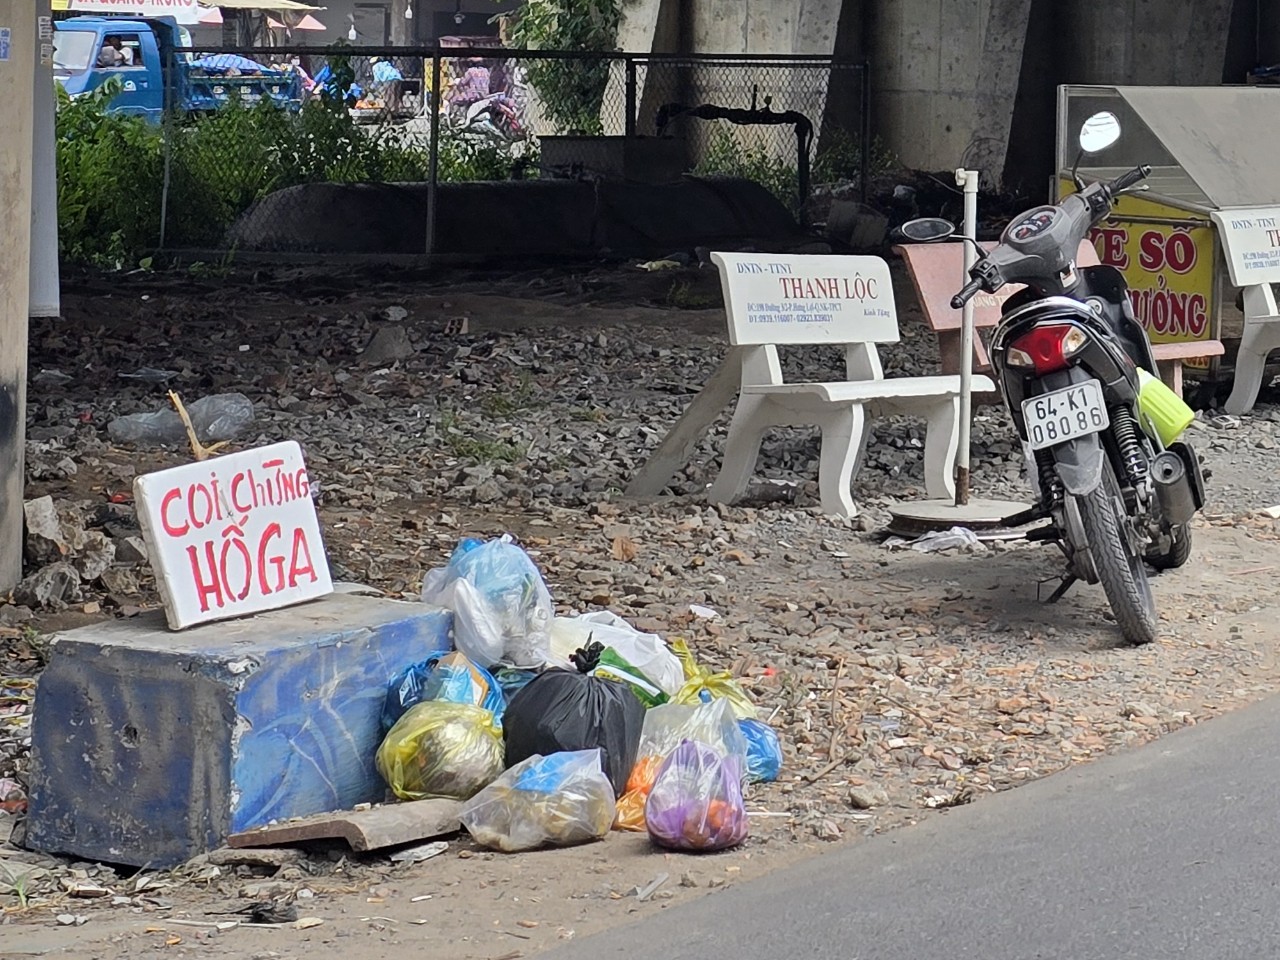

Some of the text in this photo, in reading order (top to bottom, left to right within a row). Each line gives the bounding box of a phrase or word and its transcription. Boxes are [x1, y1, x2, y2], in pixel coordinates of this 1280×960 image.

[736, 262, 763, 274] DNTN
[768, 263, 793, 274] TTNT
[779, 271, 879, 303] THANH LỘC
[1035, 388, 1087, 420] 64-K1
[1033, 407, 1101, 444] 080.86
[161, 471, 223, 537] COI
[186, 515, 318, 613] HỐ GA
